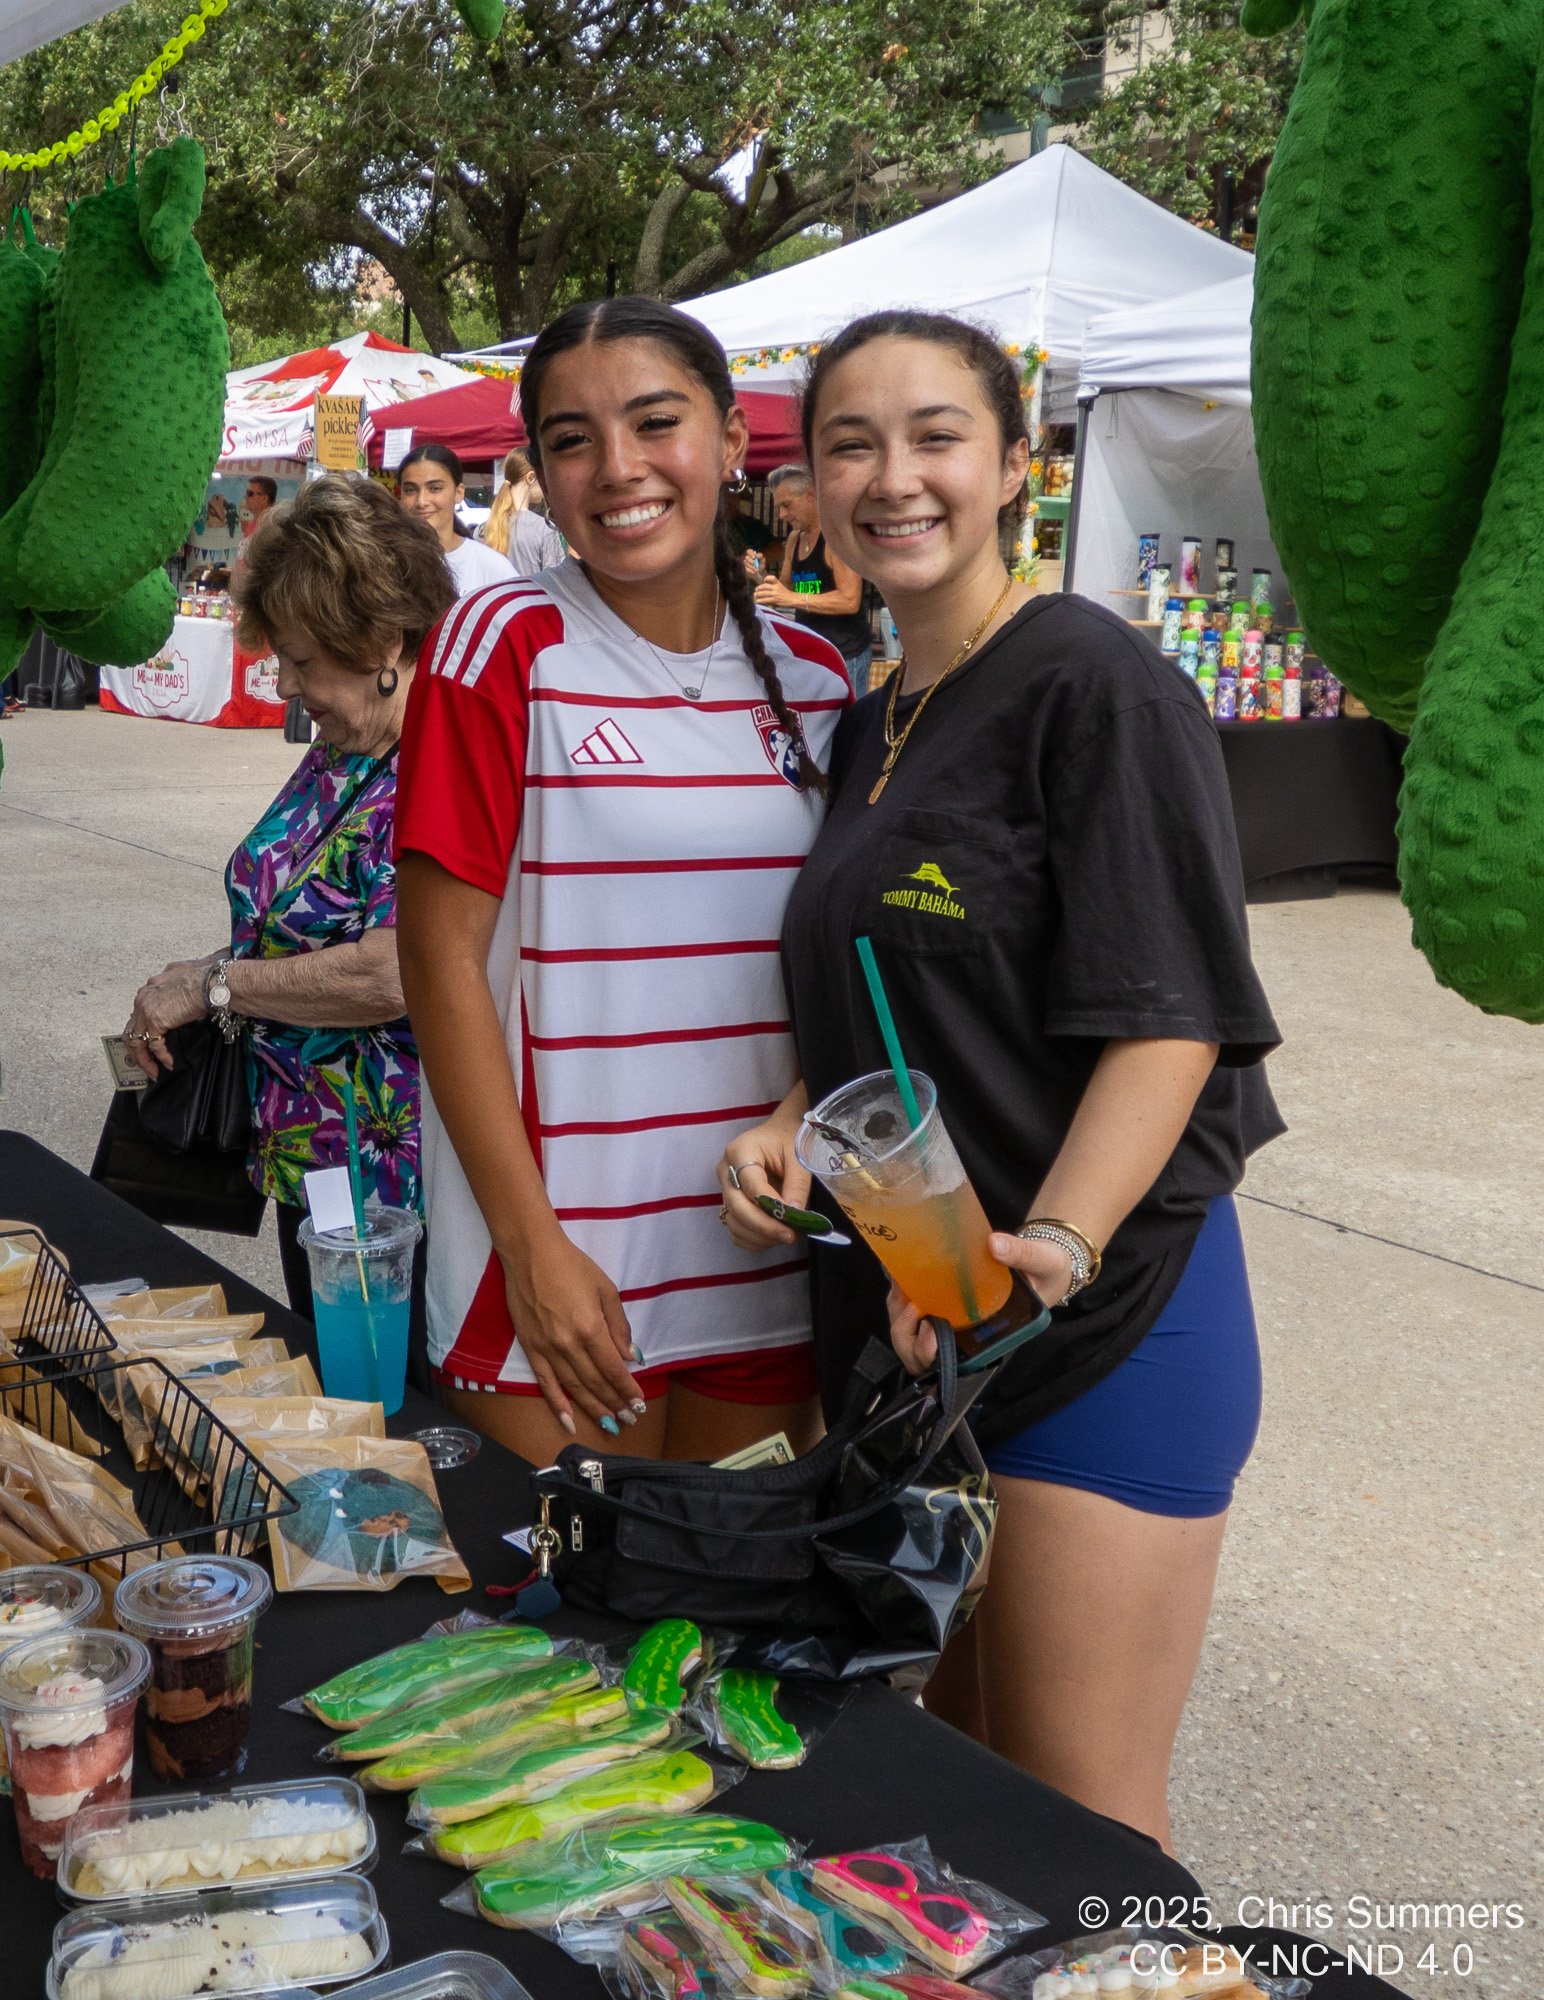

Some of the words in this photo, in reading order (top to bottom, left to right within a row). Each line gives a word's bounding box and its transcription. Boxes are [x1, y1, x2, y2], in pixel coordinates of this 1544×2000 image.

[245, 428, 289, 449] SALSA
[137, 669, 146, 684] ME
[154, 672, 164, 687] MY
[165, 673, 184, 689] DAD'S
[251, 677, 261, 688] ME
[272, 677, 278, 688] M
[883, 890, 920, 909] TOMMY
[918, 892, 965, 920] BAHAMA
